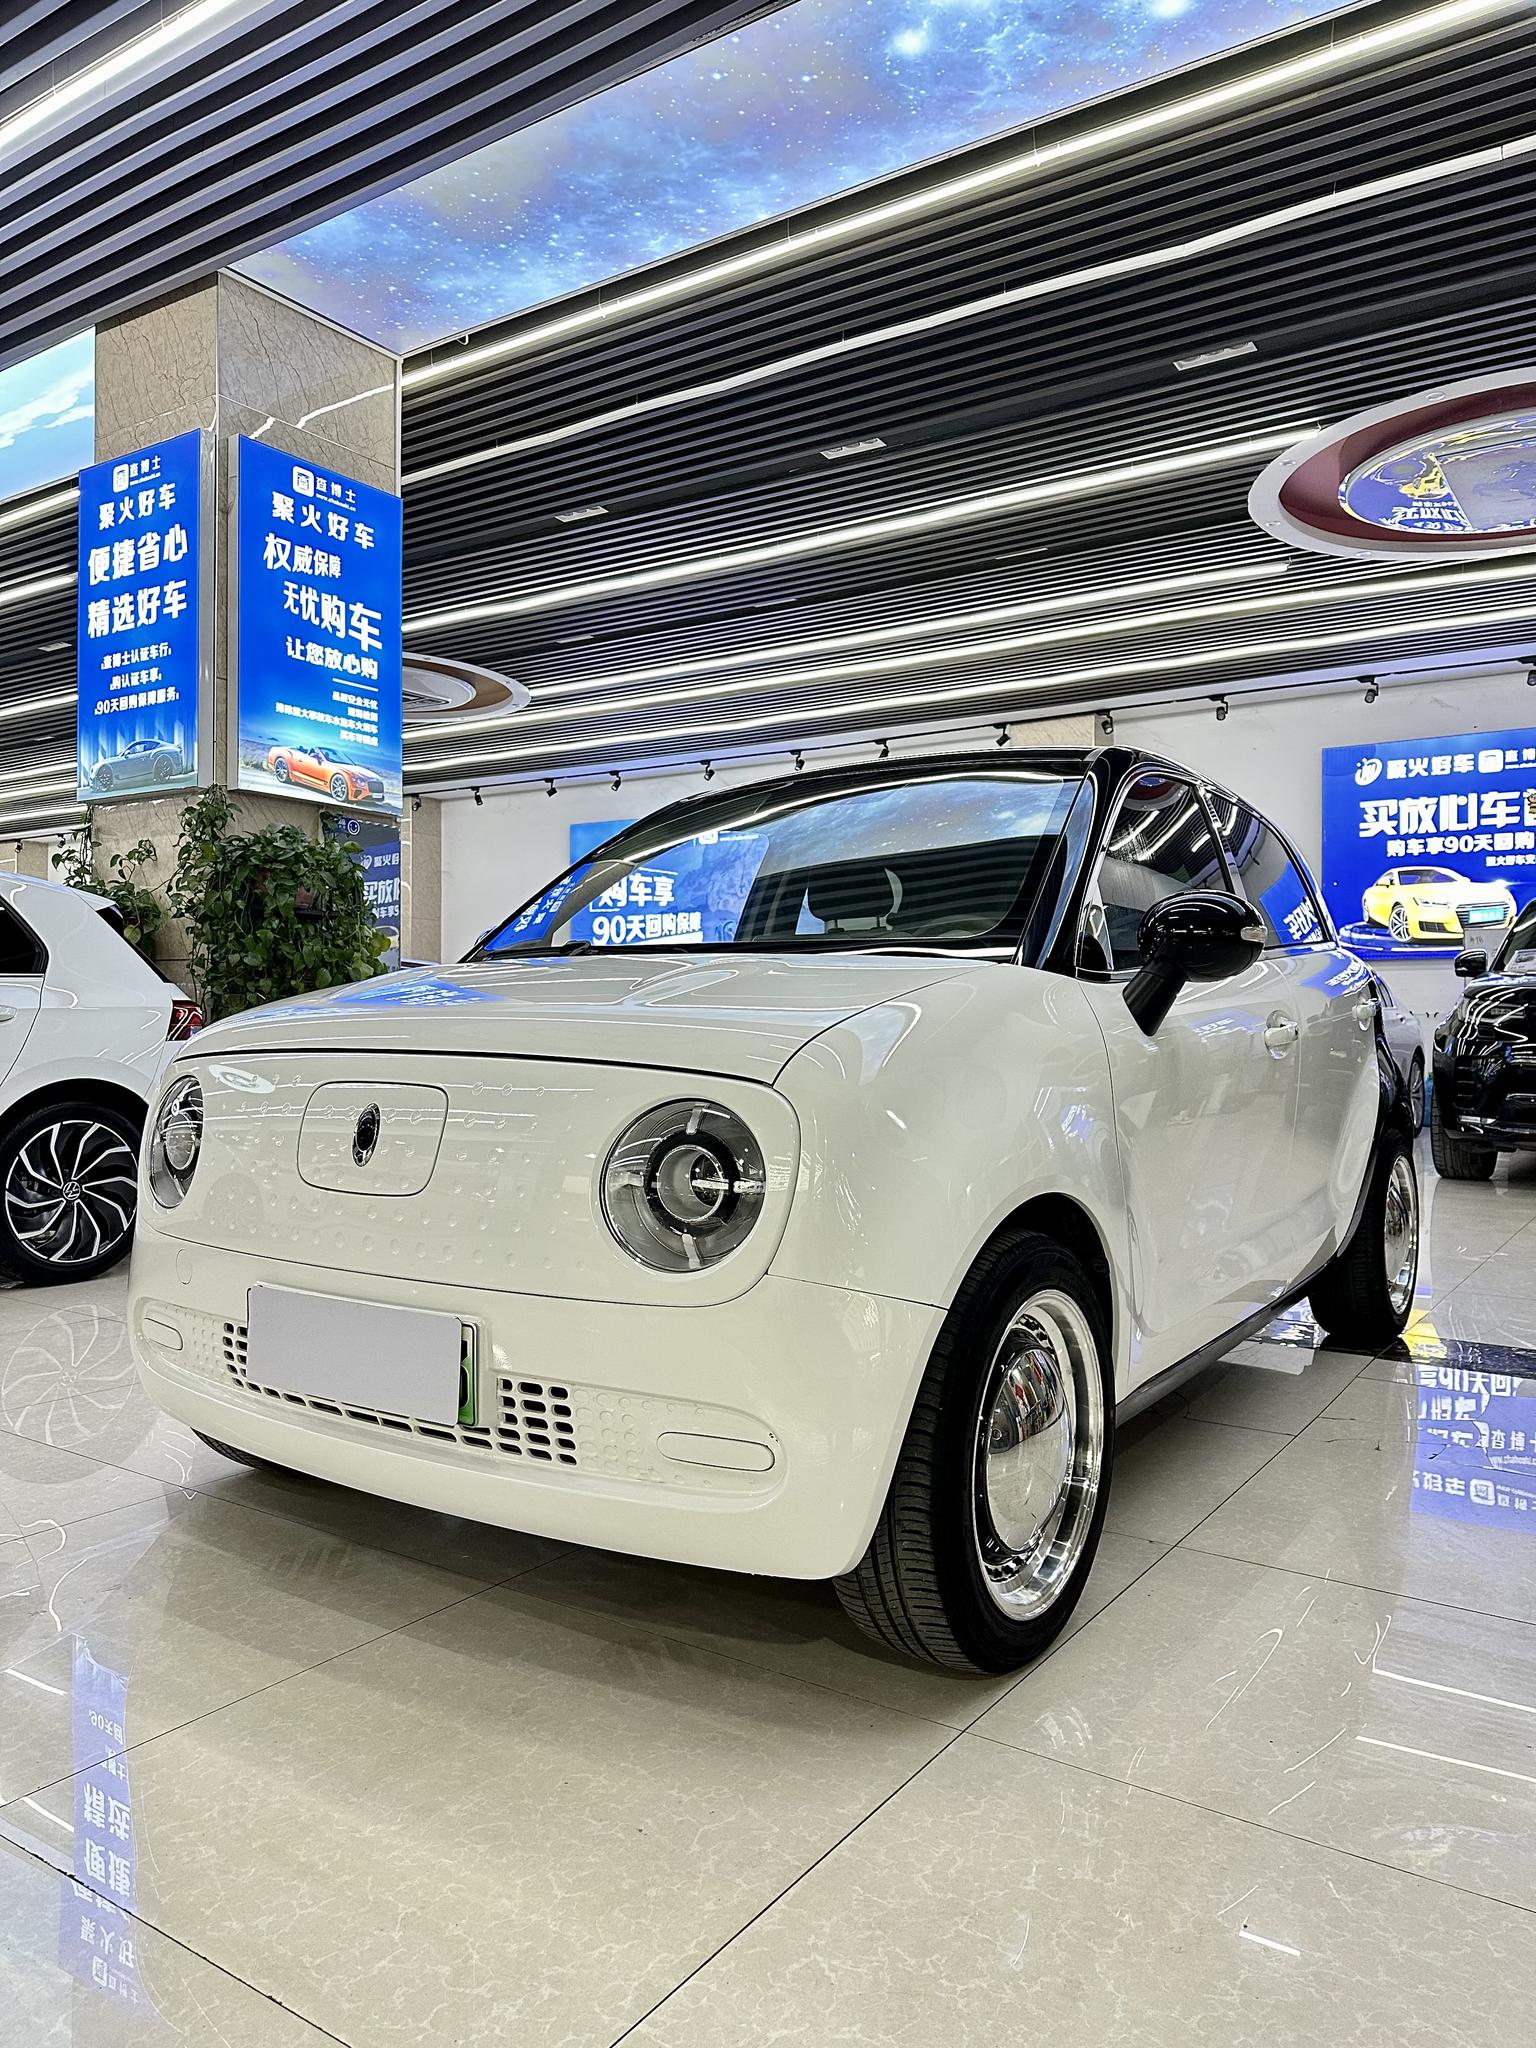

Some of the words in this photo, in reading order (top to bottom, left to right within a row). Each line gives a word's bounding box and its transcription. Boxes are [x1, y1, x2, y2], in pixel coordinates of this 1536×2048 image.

[98, 483, 176, 531] 聚火好车
[315, 477, 356, 503] 查博士
[272, 491, 375, 550] 聚火好车
[87, 523, 188, 586] 便捷省心
[263, 532, 342, 579] 权威保障
[87, 579, 187, 639] 精选好车
[283, 580, 383, 652] 无忧购车
[286, 636, 379, 681] 让您放心购
[1387, 753, 1475, 780] 聚火好车
[591, 911, 702, 946] 90天回购保障
